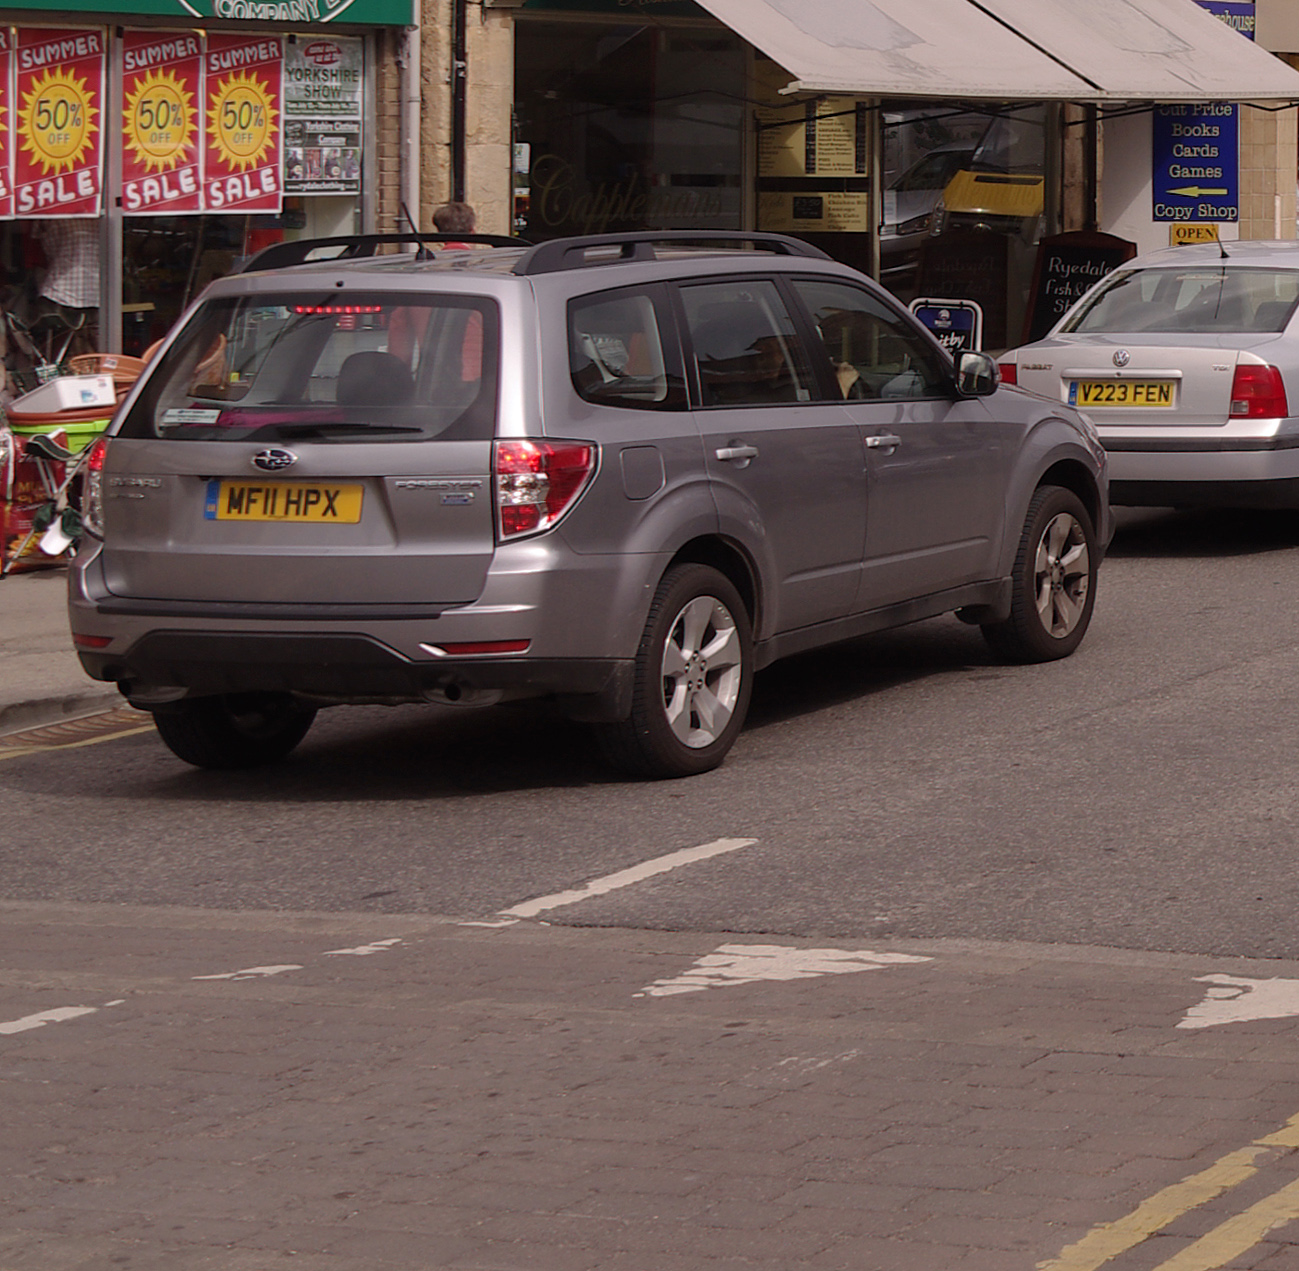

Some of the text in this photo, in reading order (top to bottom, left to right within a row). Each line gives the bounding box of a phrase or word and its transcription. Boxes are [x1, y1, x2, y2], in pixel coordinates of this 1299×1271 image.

[21, 34, 100, 69] SUMMER
[124, 36, 198, 71] SUMMER
[209, 41, 280, 72] SUMMER
[287, 68, 360, 83] YORKSHIRE
[304, 84, 342, 99] SHOW
[36, 99, 82, 131] 50%
[138, 99, 183, 130] 50%
[223, 100, 264, 130] 50%
[1159, 102, 1233, 116] Cut Price
[47, 132, 71, 146] OFF
[151, 132, 172, 145] OFF
[233, 132, 254, 145] OFF
[1171, 124, 1220, 137] Books
[1172, 144, 1219, 158] Cards
[1169, 165, 1223, 178] Games
[18, 170, 95, 213] SALE
[126, 168, 197, 210] SALE
[210, 167, 278, 208] SALE
[1155, 203, 1238, 220] Copy Shop
[1176, 227, 1215, 239] OPEN
[1049, 256, 1113, 278] Ryedale
[1053, 299, 1074, 314] Sh
[939, 331, 967, 349] itby
[1081, 383, 1171, 402] V223 FEN
[110, 477, 162, 488] SUBARU
[395, 480, 483, 490] FORESTER
[227, 487, 340, 517] MF11 HPX
